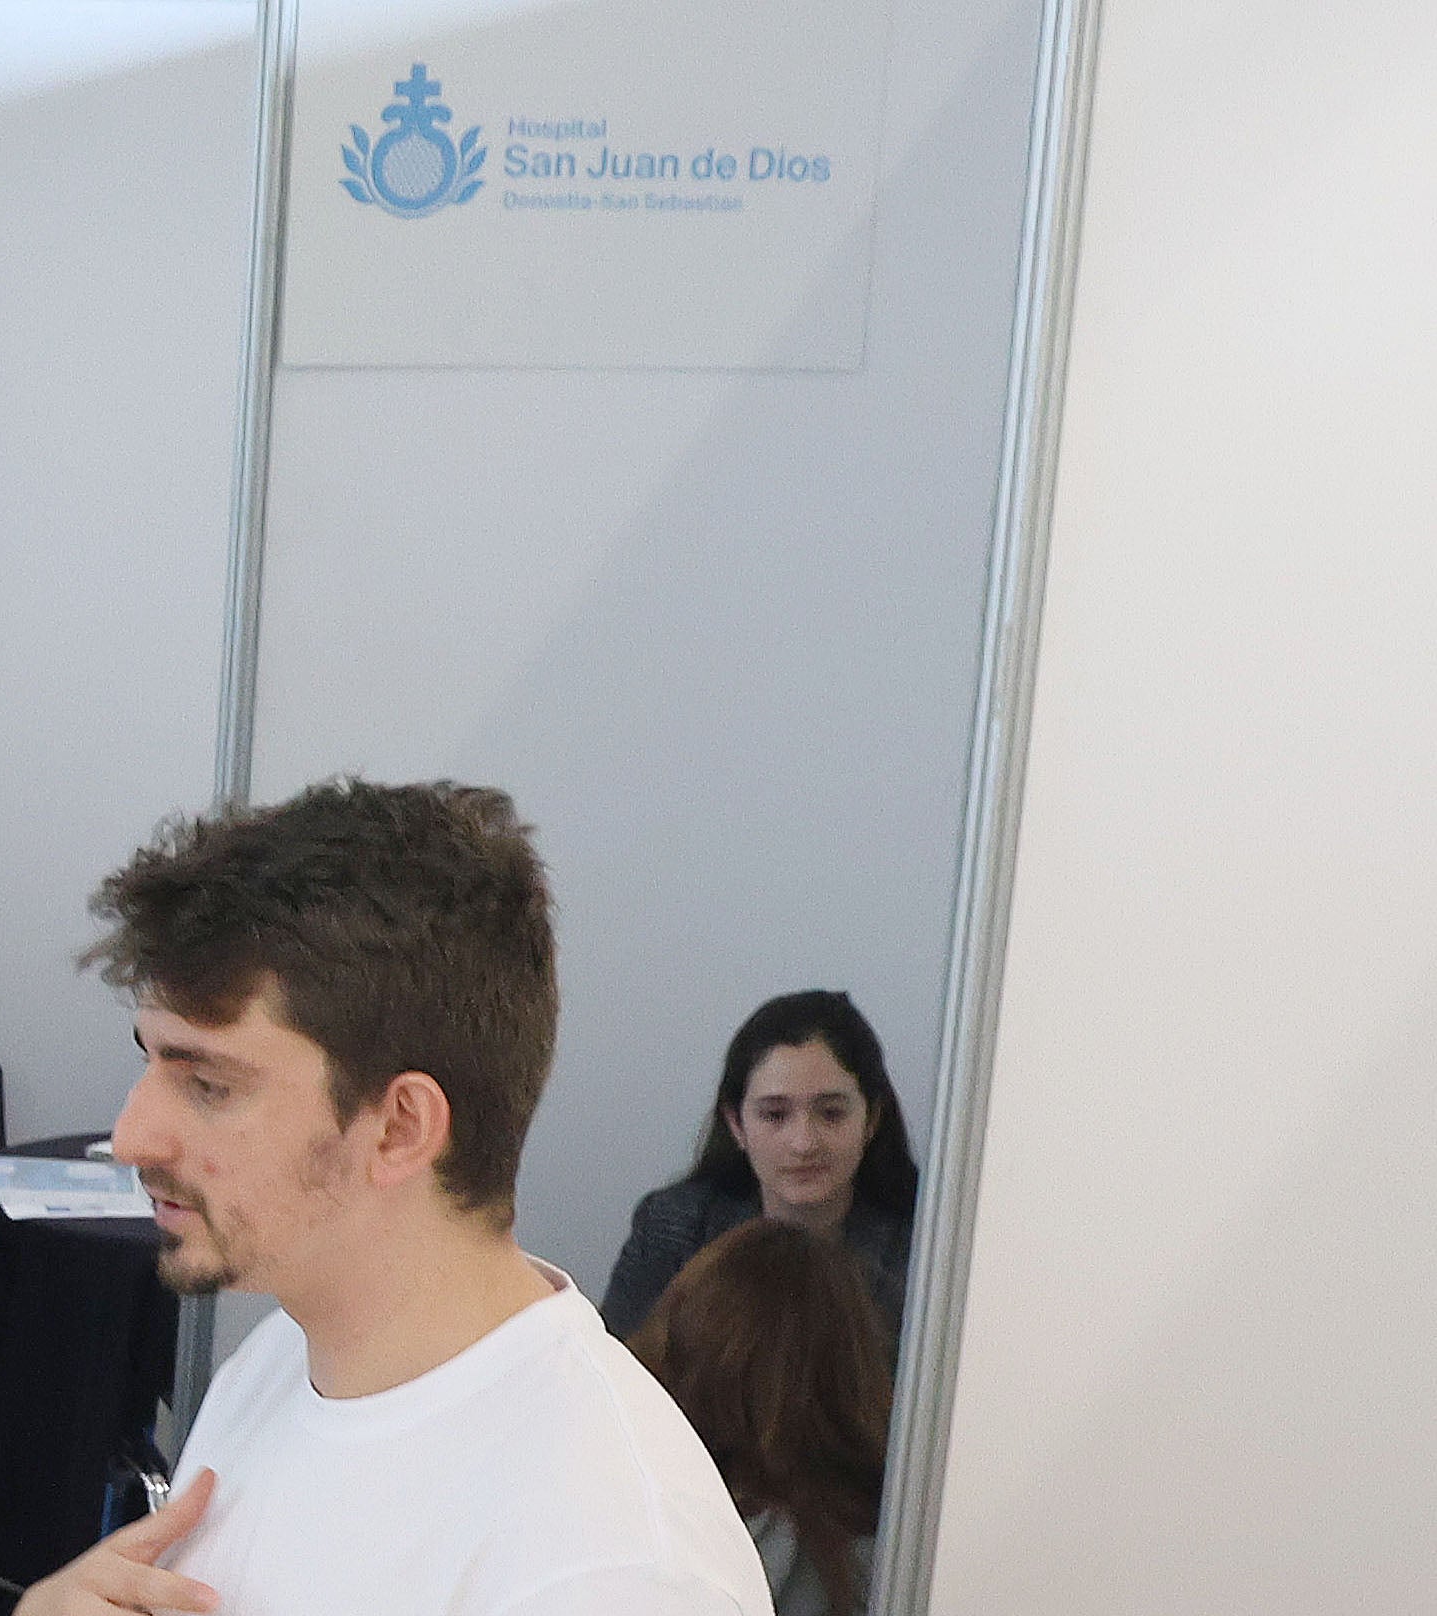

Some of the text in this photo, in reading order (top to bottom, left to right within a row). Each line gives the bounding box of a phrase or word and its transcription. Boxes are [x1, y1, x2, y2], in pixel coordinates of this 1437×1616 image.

[508, 117, 607, 140] Hospital
[503, 143, 832, 182] San Juan de Dios
